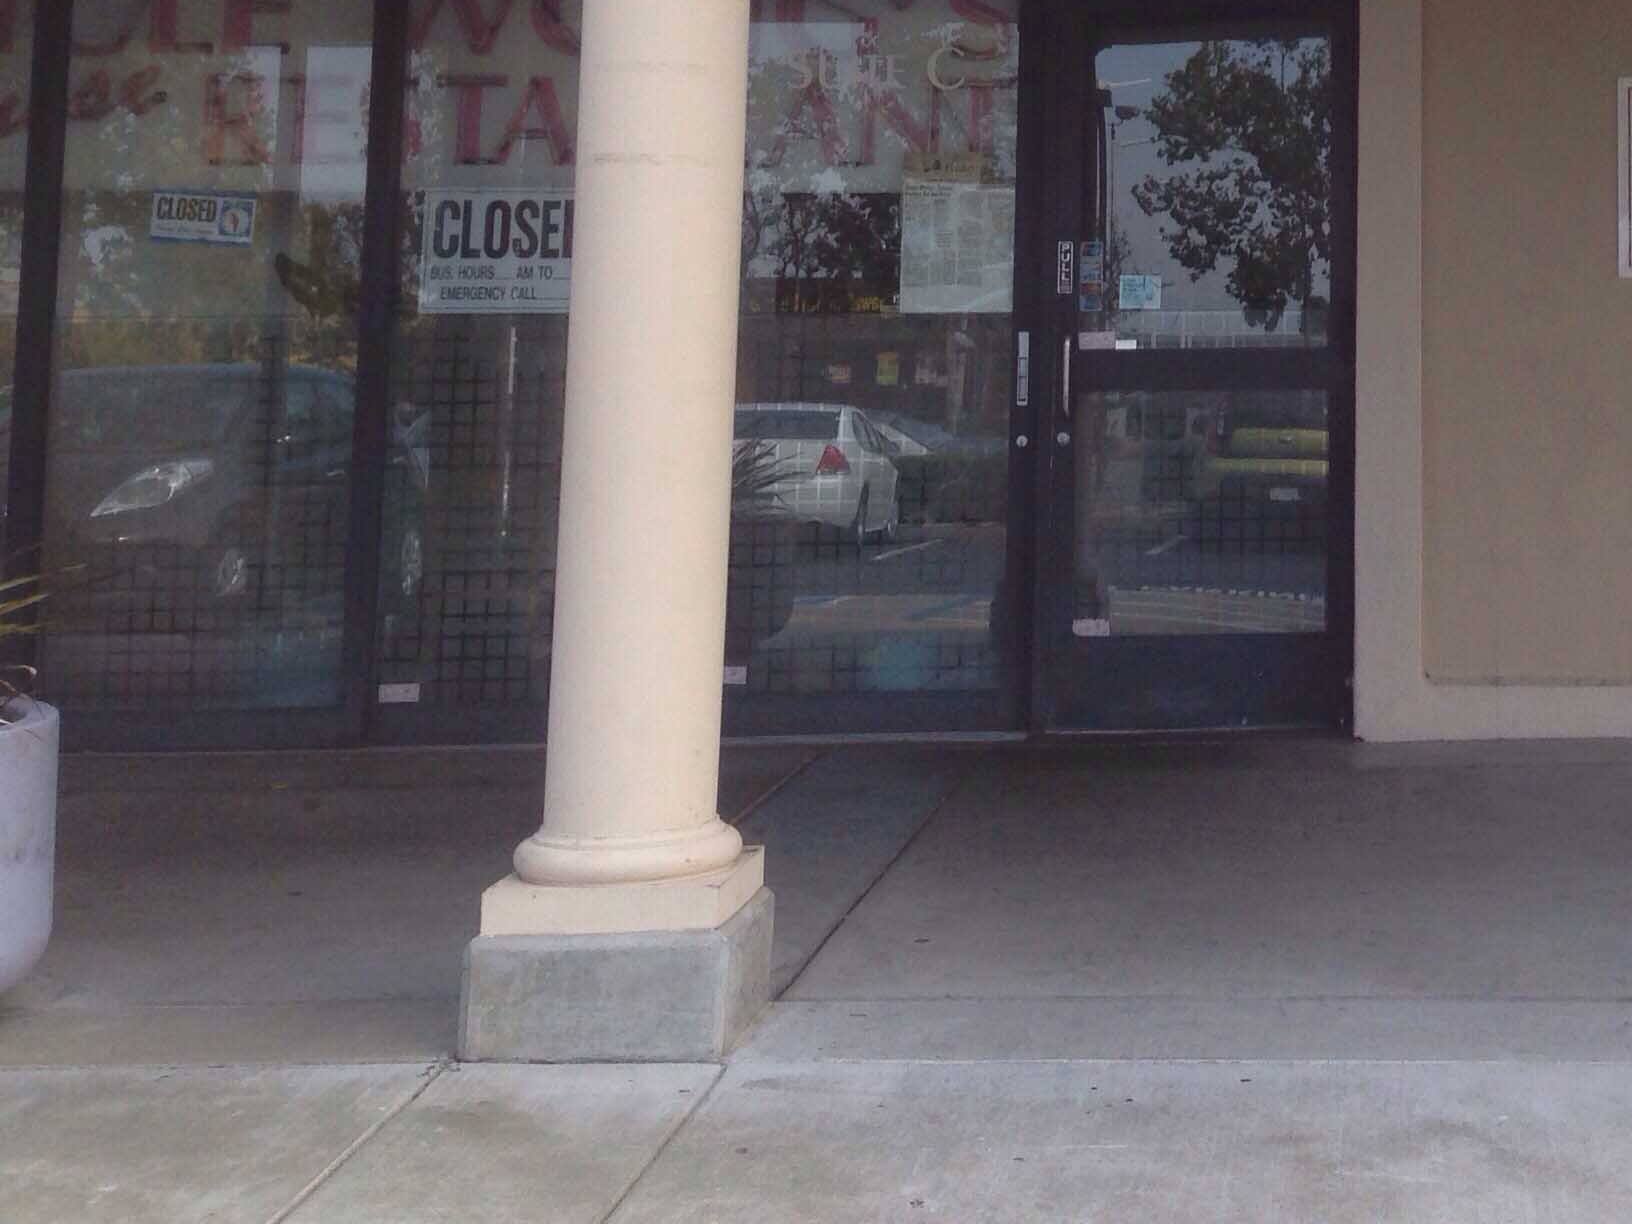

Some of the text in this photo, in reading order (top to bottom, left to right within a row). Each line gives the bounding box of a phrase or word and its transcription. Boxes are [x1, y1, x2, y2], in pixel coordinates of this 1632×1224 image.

[157, 196, 217, 223] CLOSED
[458, 264, 496, 280] HOURS
[439, 285, 537, 301] EMERGENCY CALL
